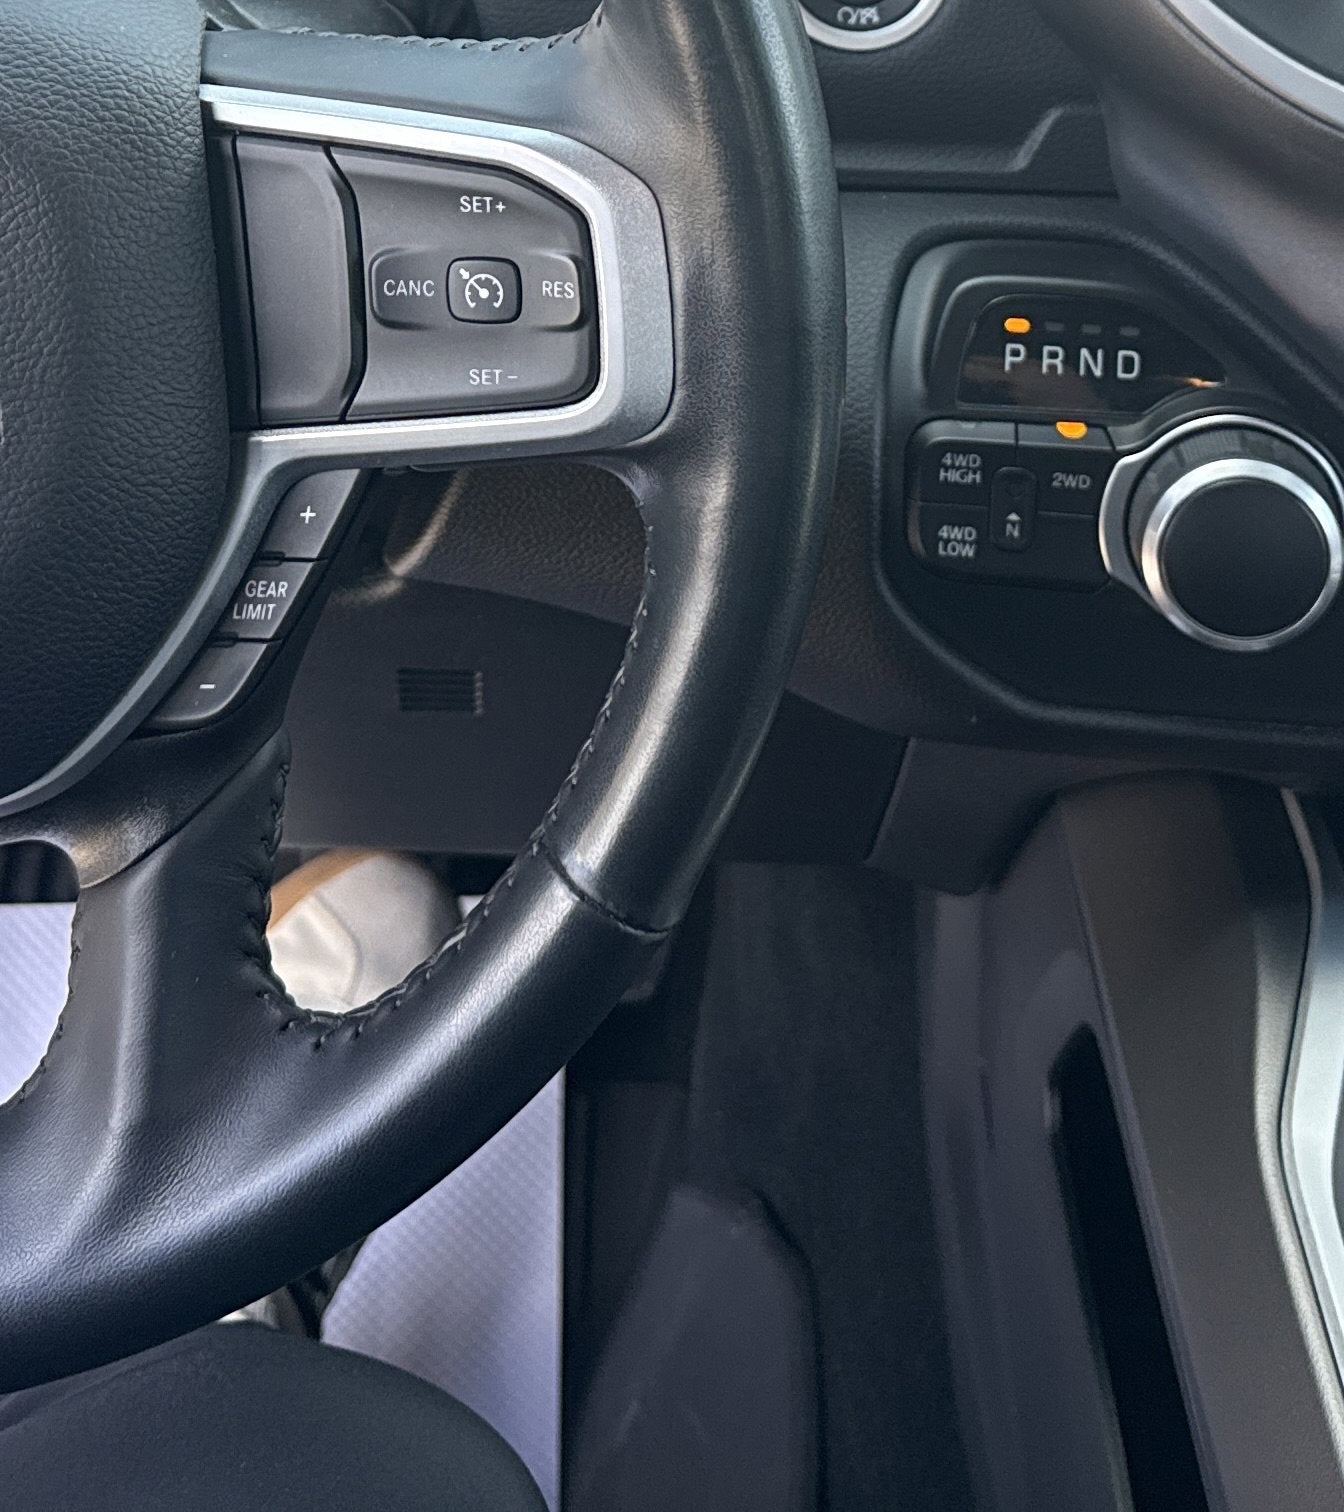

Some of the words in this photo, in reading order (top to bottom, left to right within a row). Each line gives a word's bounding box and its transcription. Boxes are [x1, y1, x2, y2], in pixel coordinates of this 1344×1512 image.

[383, 280, 435, 297] CANC
[541, 281, 574, 299] RES
[1004, 343, 1027, 373] P
[1041, 345, 1065, 376] R
[1079, 347, 1104, 379] N
[1116, 349, 1141, 380] D
[941, 452, 981, 468] 4WD
[939, 468, 981, 484] HIGH
[1052, 472, 1091, 489] 2WD
[938, 525, 976, 541] 4WD
[1005, 522, 1021, 539] N
[937, 541, 976, 557] LOW
[244, 580, 288, 598] GEAR
[232, 603, 276, 621] LIMIT
